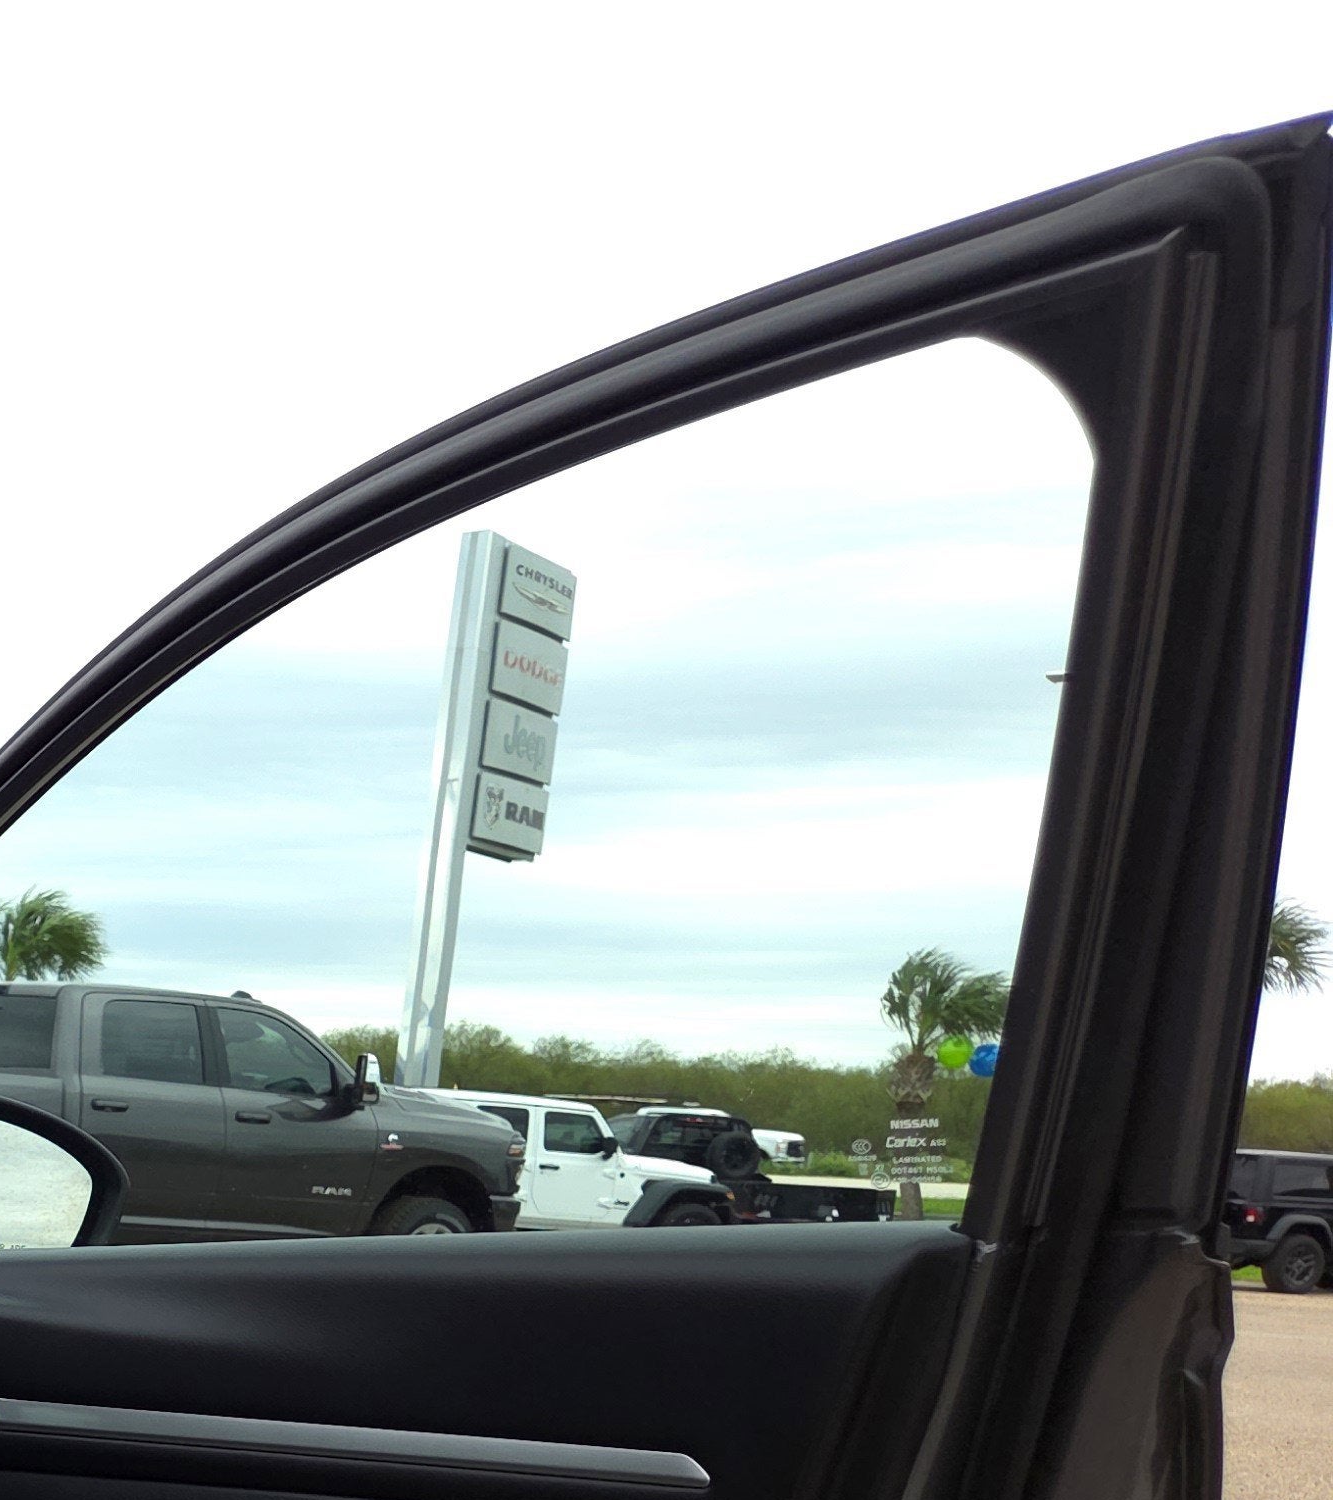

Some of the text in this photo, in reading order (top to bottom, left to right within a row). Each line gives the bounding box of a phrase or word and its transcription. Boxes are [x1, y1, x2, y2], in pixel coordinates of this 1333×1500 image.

[516, 563, 573, 599] CHRYSLER
[503, 650, 562, 687] DODGE
[503, 714, 546, 773] Jeep
[504, 801, 545, 832] RAM
[890, 1118, 939, 1129] NISSAN
